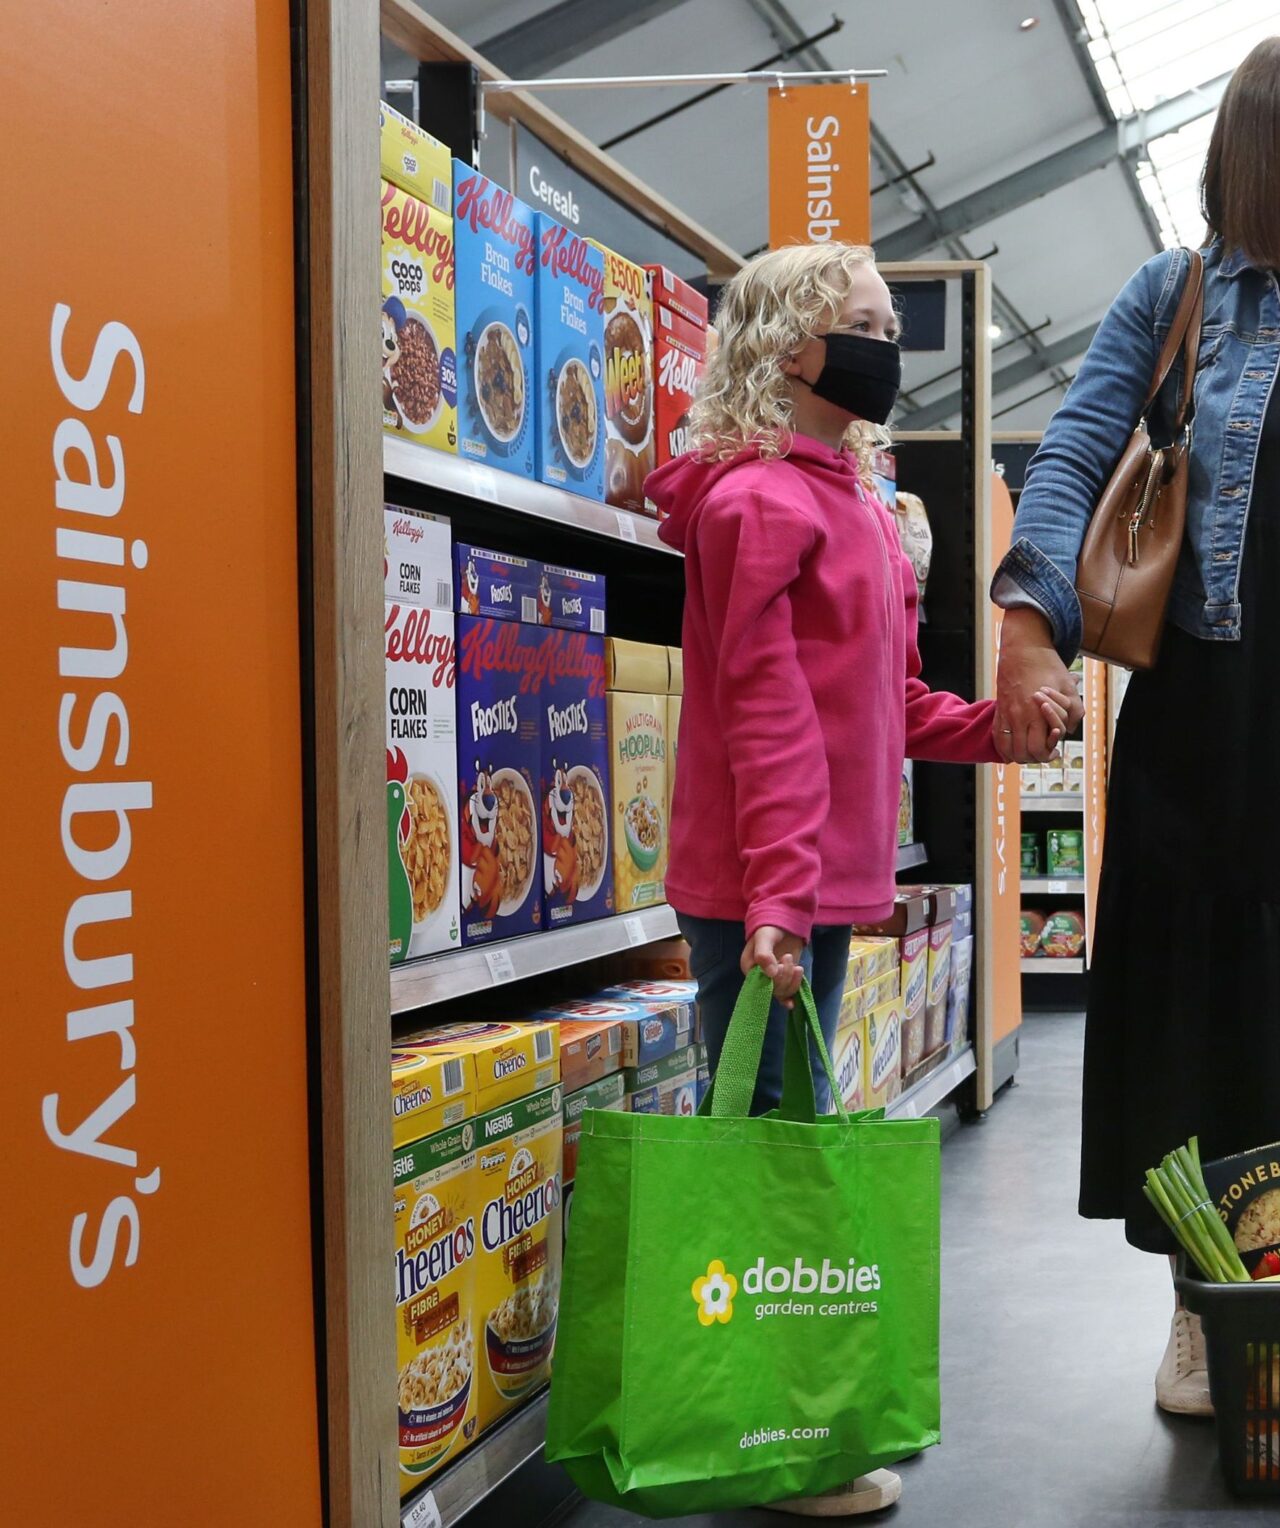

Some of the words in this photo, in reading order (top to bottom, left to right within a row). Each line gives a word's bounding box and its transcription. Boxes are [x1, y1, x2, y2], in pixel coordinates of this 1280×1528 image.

[806, 115, 840, 243] Sainsb
[529, 166, 580, 225] Cereals
[485, 242, 510, 273] Bran
[398, 278, 421, 297] pops
[480, 262, 513, 297] Flakes
[611, 255, 641, 297] £500
[563, 286, 585, 313] Bran
[560, 305, 587, 335] Flakes
[606, 346, 644, 419] Weet
[392, 518, 424, 544] Kellogg's
[400, 562, 421, 580] CORN
[400, 580, 421, 594] FLAKES
[490, 584, 512, 605] FROSTIES
[562, 597, 582, 616] FROSTIES
[389, 687, 427, 716] CORN
[391, 718, 427, 740] FLAKES
[471, 695, 518, 743] FROSTIES
[547, 699, 588, 743] FROSTIES
[626, 712, 663, 734] MULTIGRAIN
[619, 734, 665, 763] HOOPLAS
[42, 302, 160, 1288] Sainsbury's
[493, 1052, 526, 1079] Cheerios
[393, 1085, 432, 1116] Cheerios
[507, 1165, 537, 1199] HONEY
[482, 1172, 561, 1250] Cheerios
[407, 1212, 444, 1250] HONEY
[395, 1218, 474, 1303] heerios
[508, 1236, 532, 1260] FIBRE
[742, 1257, 881, 1294] dobbies
[411, 1292, 438, 1320] FIBRE
[755, 1299, 814, 1320] garden
[818, 1300, 878, 1316] centres
[739, 1426, 830, 1450] dobbies.com
